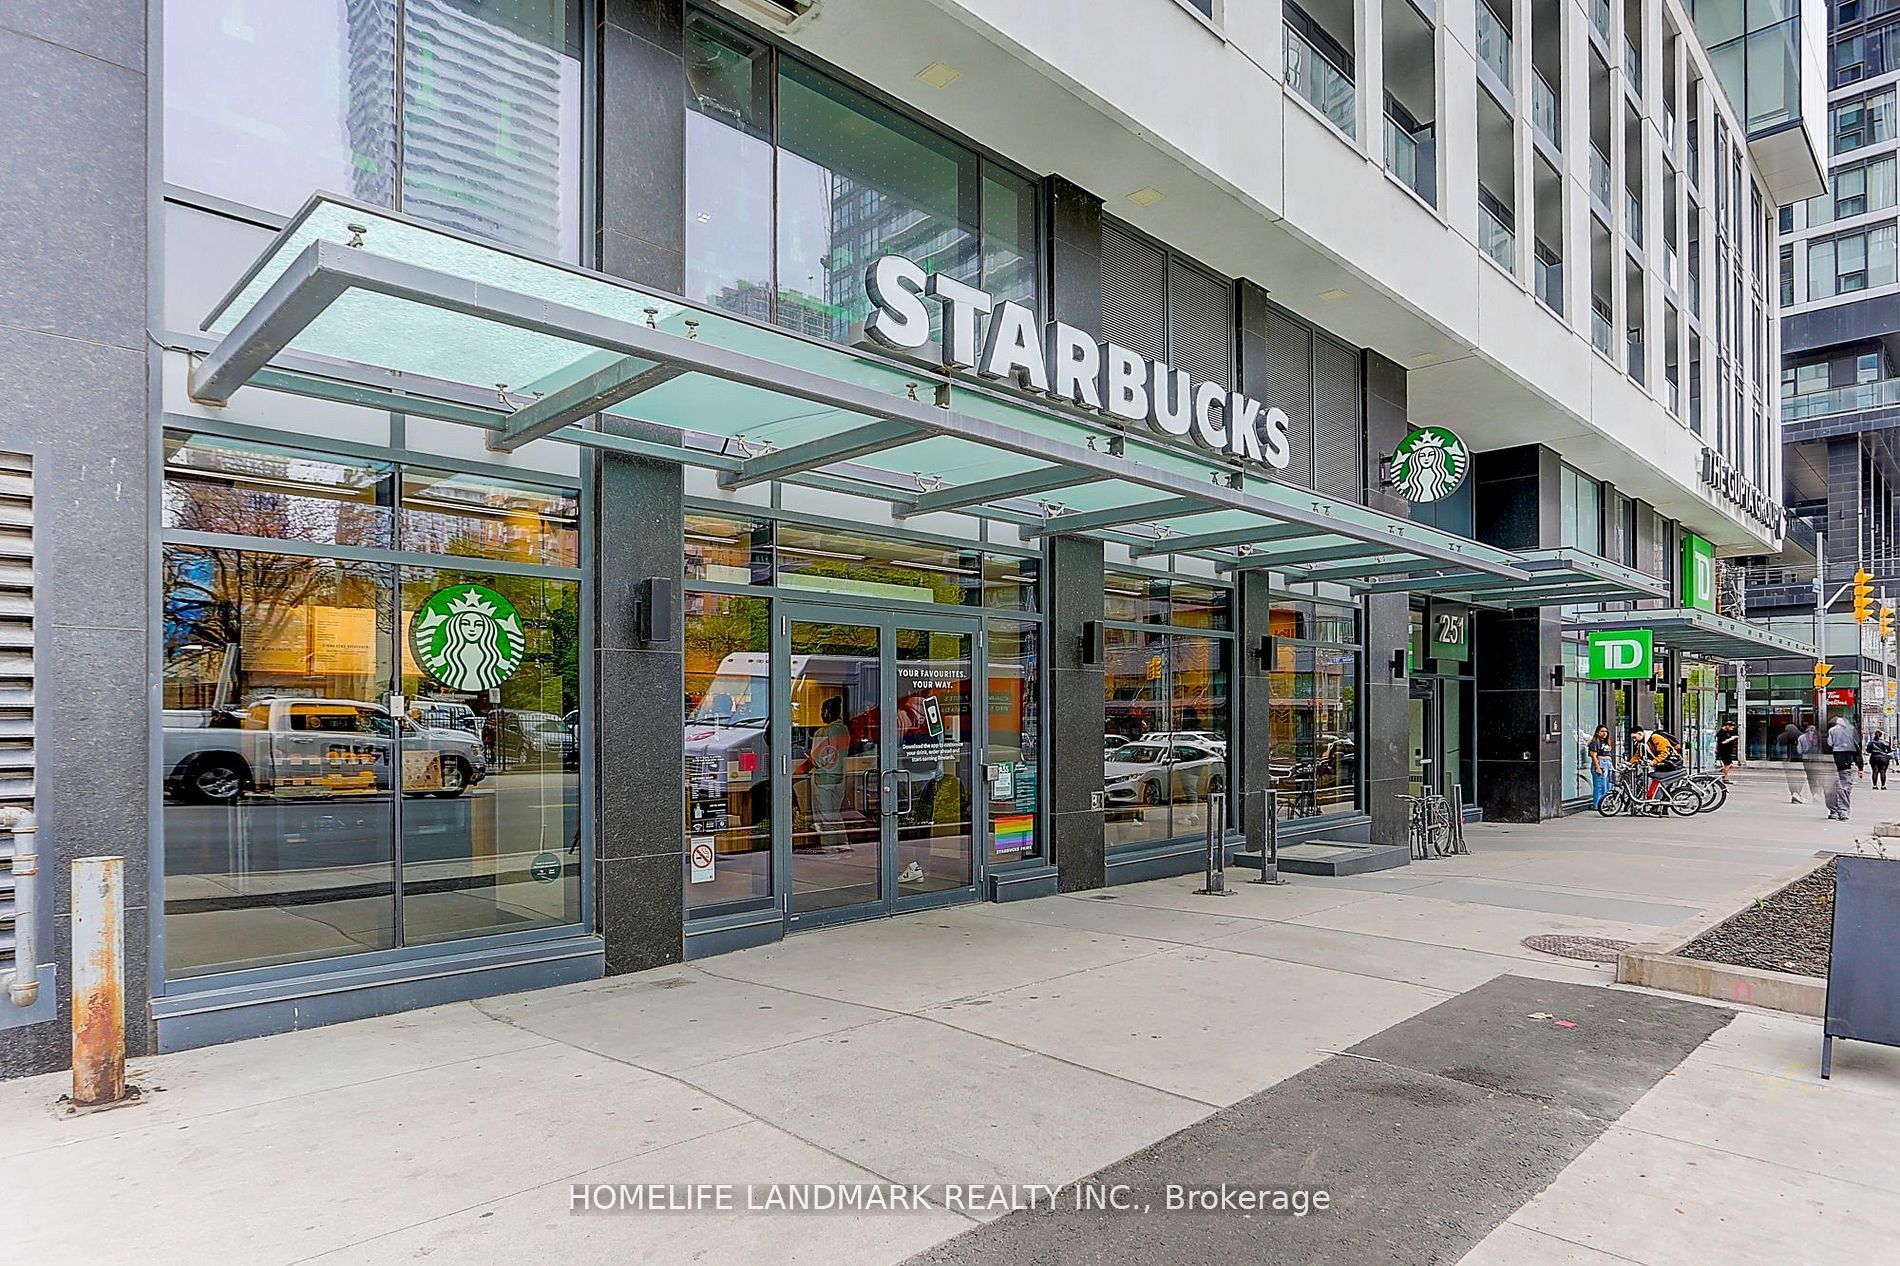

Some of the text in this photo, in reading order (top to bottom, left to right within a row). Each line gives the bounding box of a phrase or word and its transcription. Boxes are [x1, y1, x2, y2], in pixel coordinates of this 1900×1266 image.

[865, 254, 1291, 471] STARBUCKS
[1701, 447, 1782, 540] THE GUPTA GROUP
[1694, 551, 1711, 601] TD
[1438, 613, 1465, 645] 251
[1594, 639, 1644, 670] TD
[898, 669, 966, 678] YOUR FAVOURITES.
[1827, 691, 1840, 699] Tim
[999, 765, 1009, 773] ASS
[996, 846, 1020, 854] STARBUCKS
